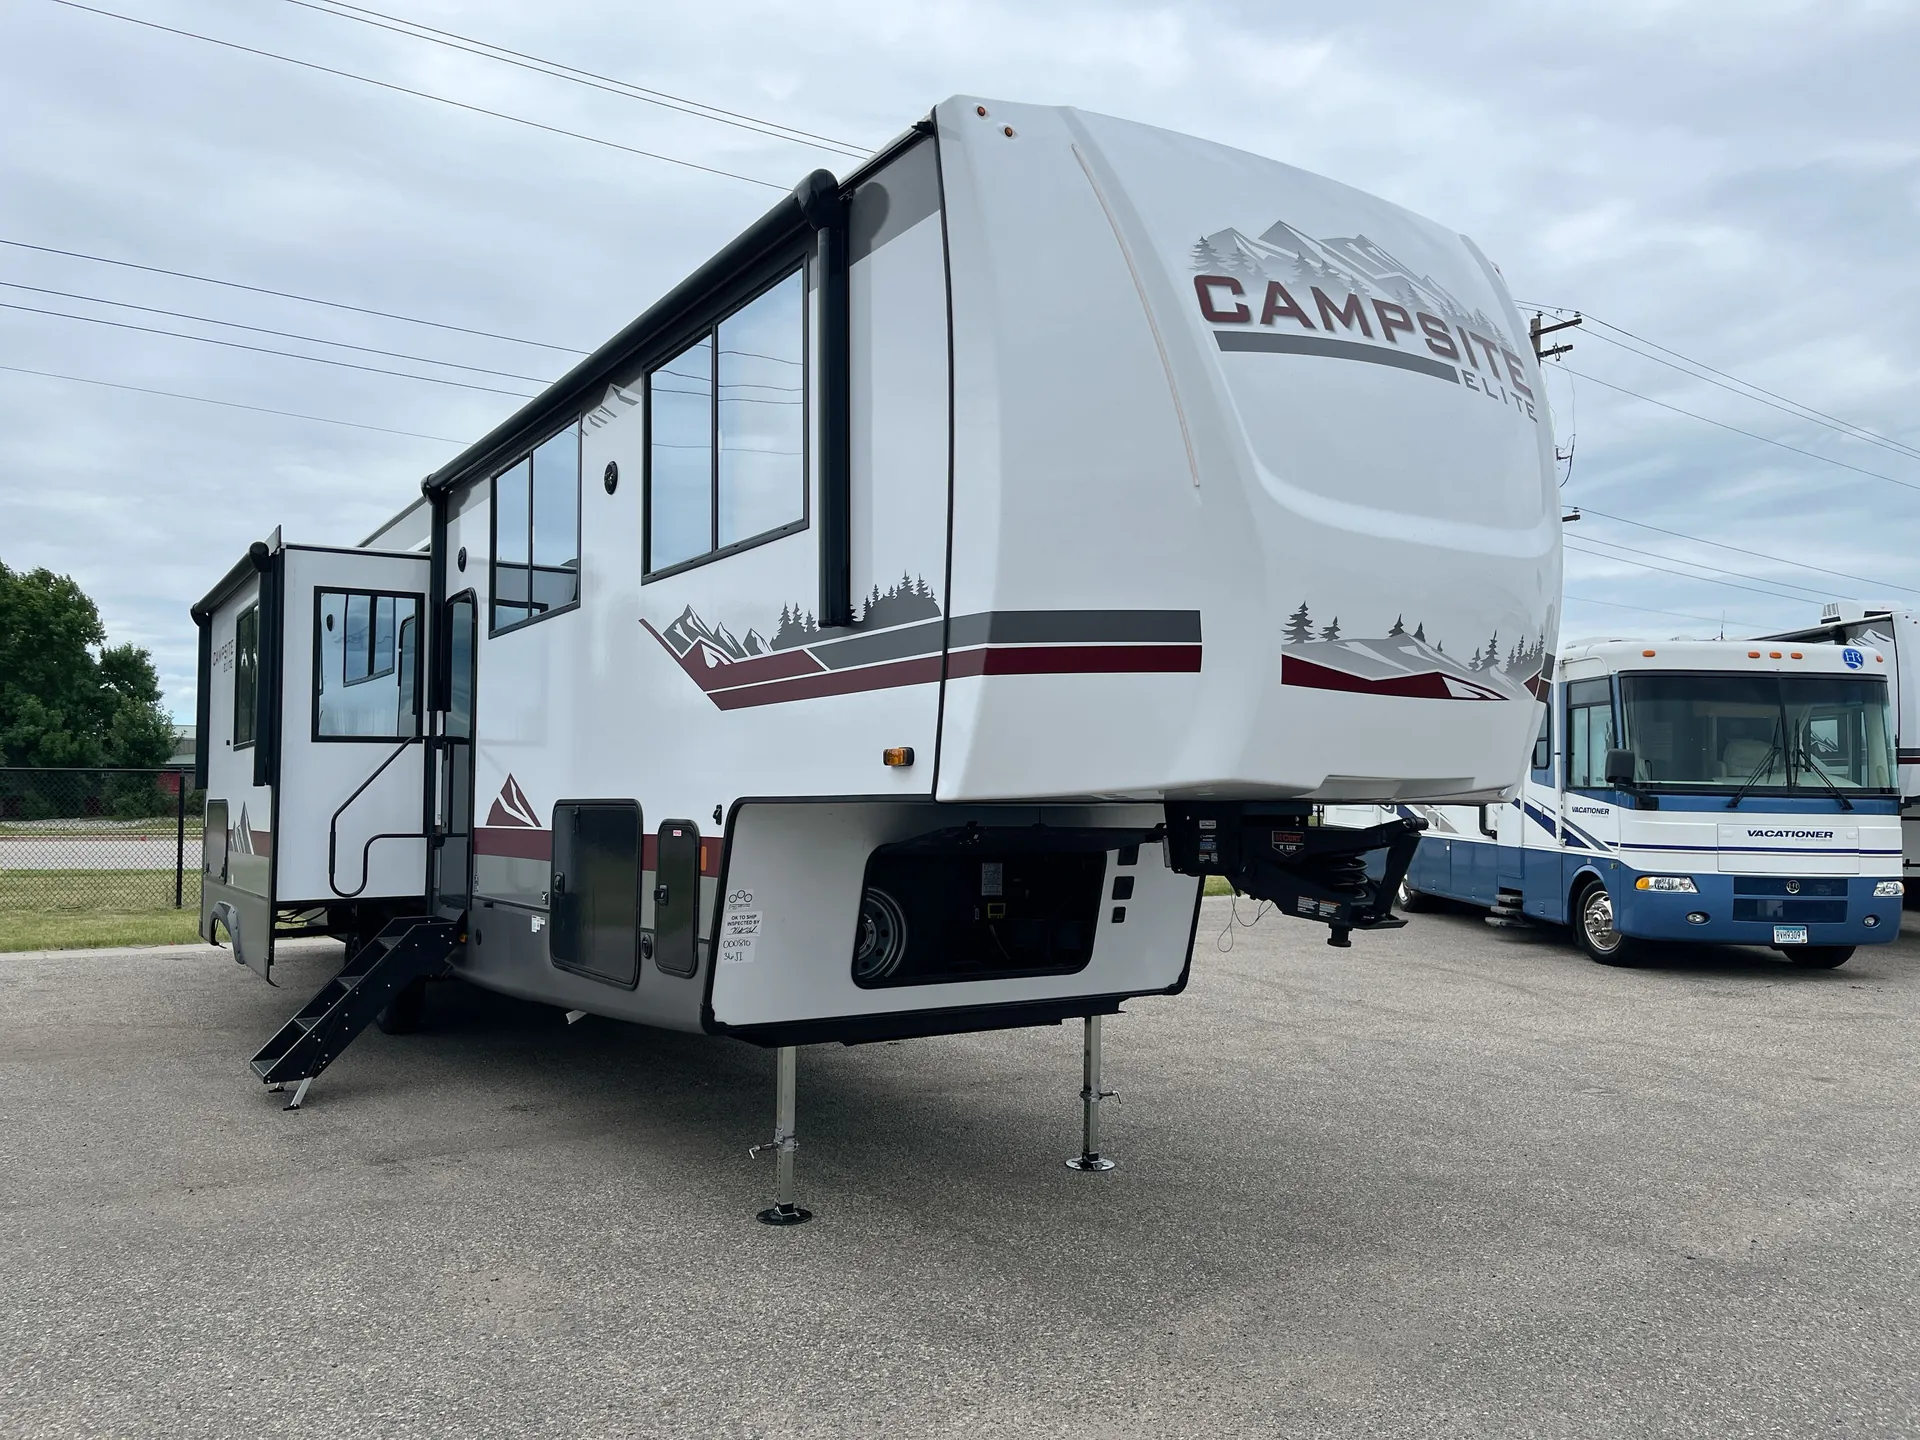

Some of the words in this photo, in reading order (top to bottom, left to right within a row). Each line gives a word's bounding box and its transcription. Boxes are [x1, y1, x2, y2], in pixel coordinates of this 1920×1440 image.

[1193, 274, 1534, 401] CAMPSITE
[1460, 368, 1539, 424] ELITE
[1571, 806, 1610, 815] VACATIONER
[1747, 829, 1834, 839] VACATIONER
